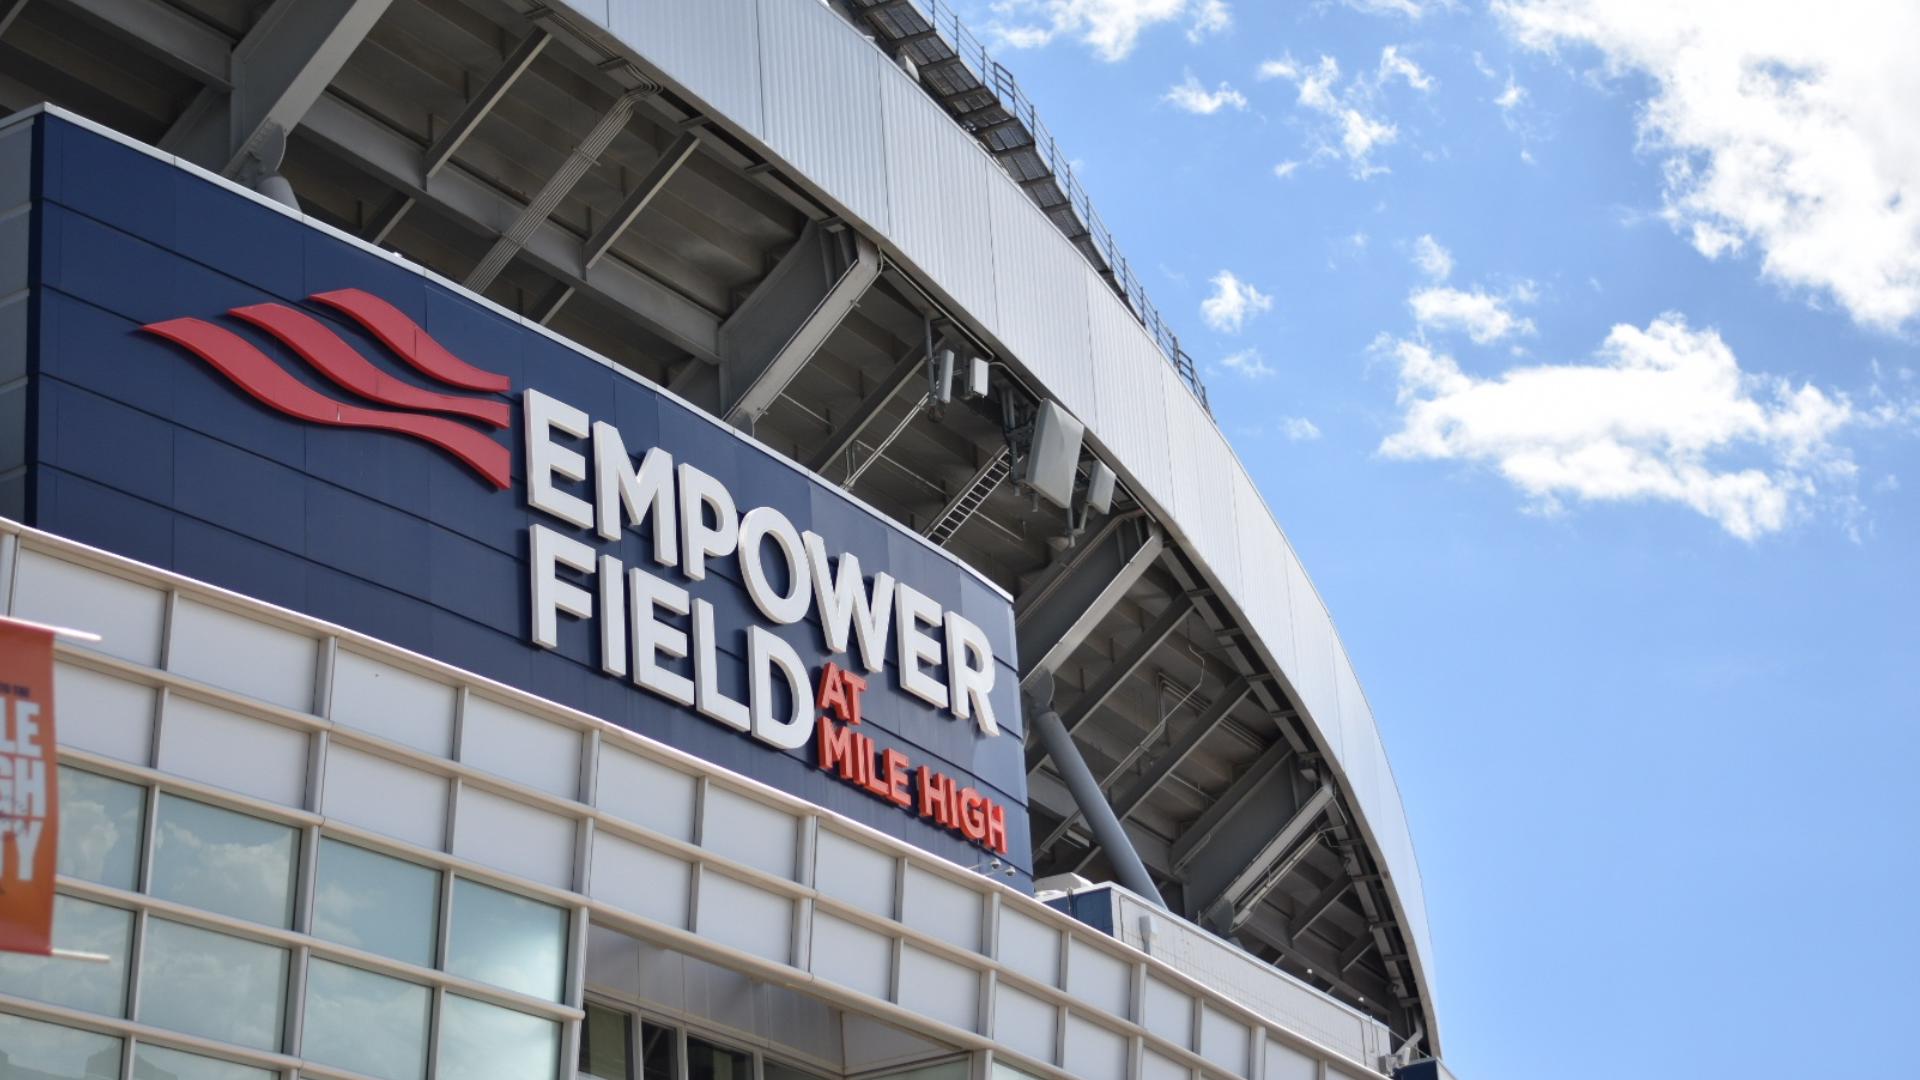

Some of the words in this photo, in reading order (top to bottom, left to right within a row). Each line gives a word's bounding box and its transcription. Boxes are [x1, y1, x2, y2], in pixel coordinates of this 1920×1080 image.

[523, 388, 1000, 736] EMPOWER
[529, 524, 815, 749] FIELD
[816, 661, 867, 725] AT
[817, 716, 911, 807] MILE
[916, 764, 1008, 855] HIGH
